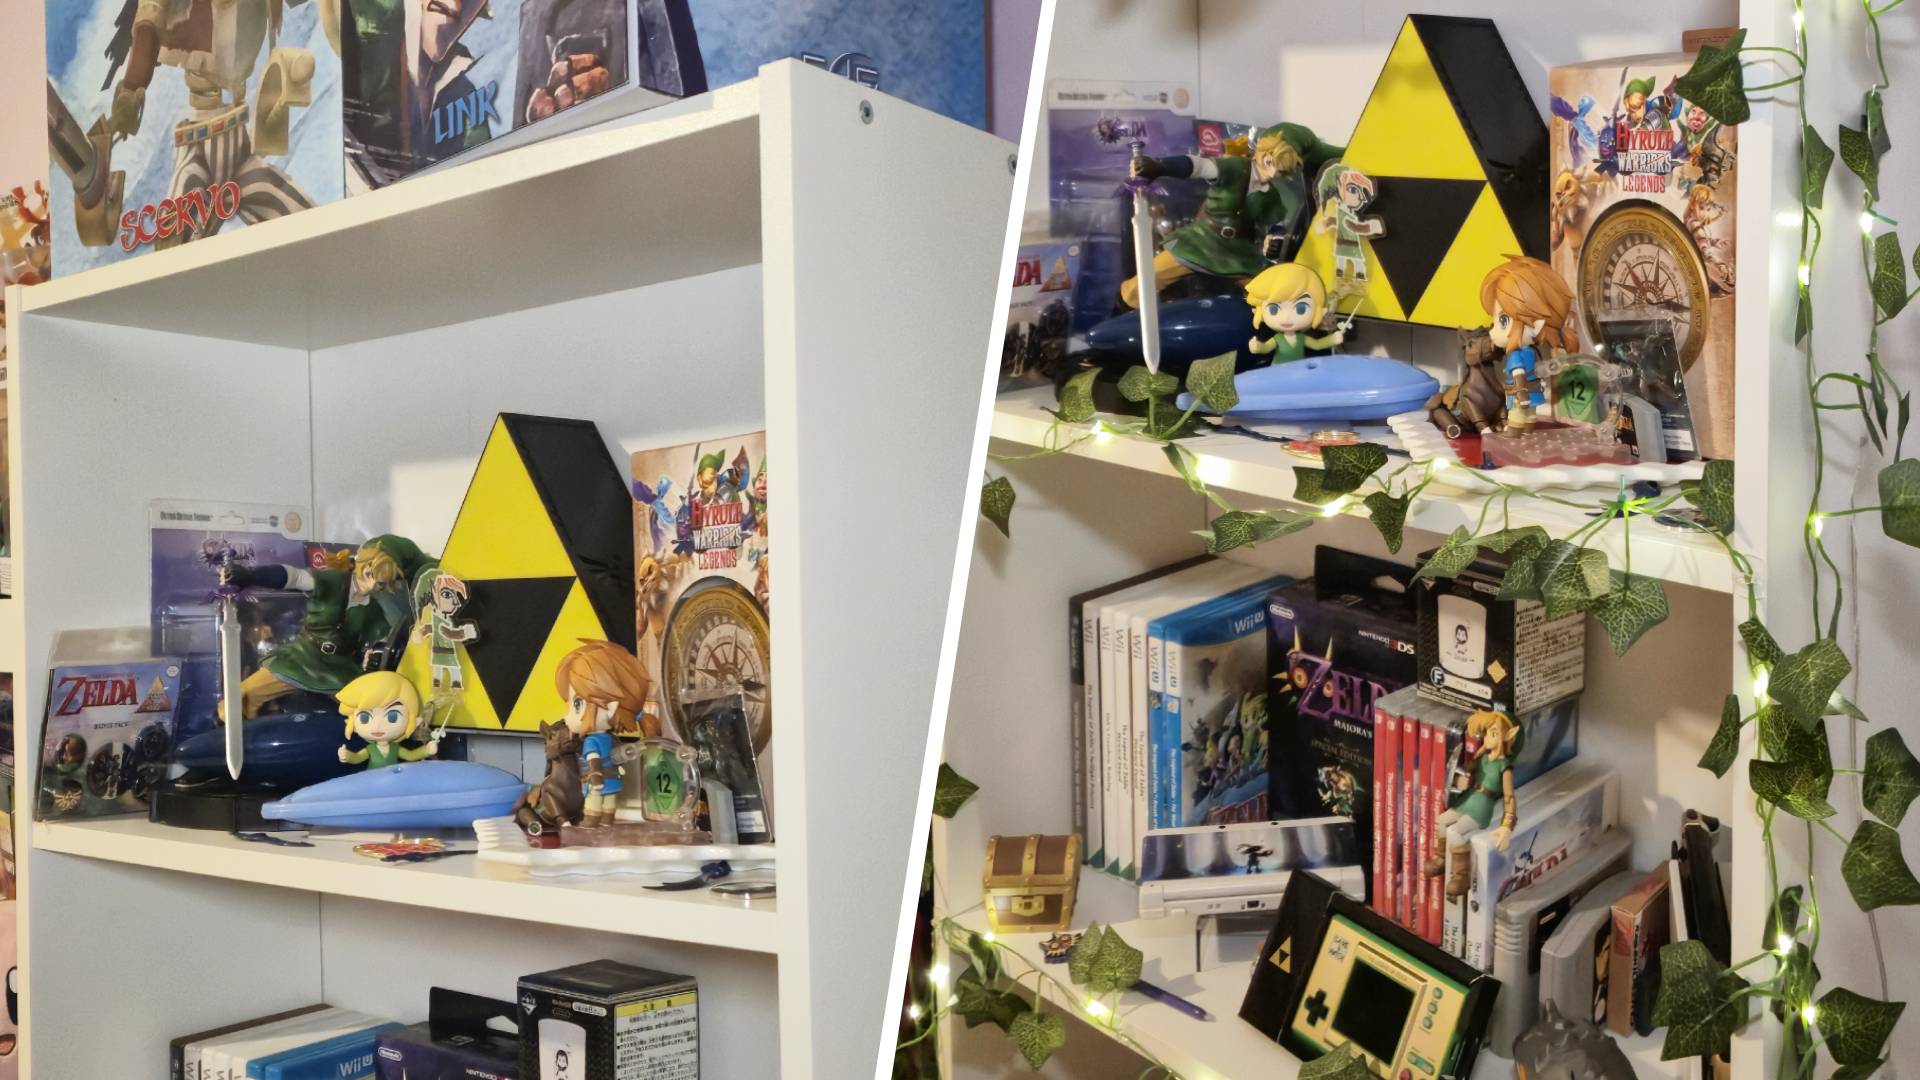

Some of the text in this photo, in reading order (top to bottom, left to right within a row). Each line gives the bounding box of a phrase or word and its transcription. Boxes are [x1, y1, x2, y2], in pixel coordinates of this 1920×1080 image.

[432, 79, 500, 145] LINK
[1615, 121, 1674, 152] HYRULE
[1617, 151, 1672, 173] WARRIORS
[1622, 174, 1666, 193] LEGENDS
[118, 181, 241, 252] SCERVO
[1568, 380, 1585, 400] 12
[692, 526, 742, 549] WARRIORS
[699, 548, 737, 570] LEGENDS
[1234, 614, 1254, 635] Wii
[55, 676, 139, 716] ZELDA
[1286, 649, 1390, 725] ZELD
[655, 772, 672, 794] 12
[339, 1057, 362, 1078] Wii
